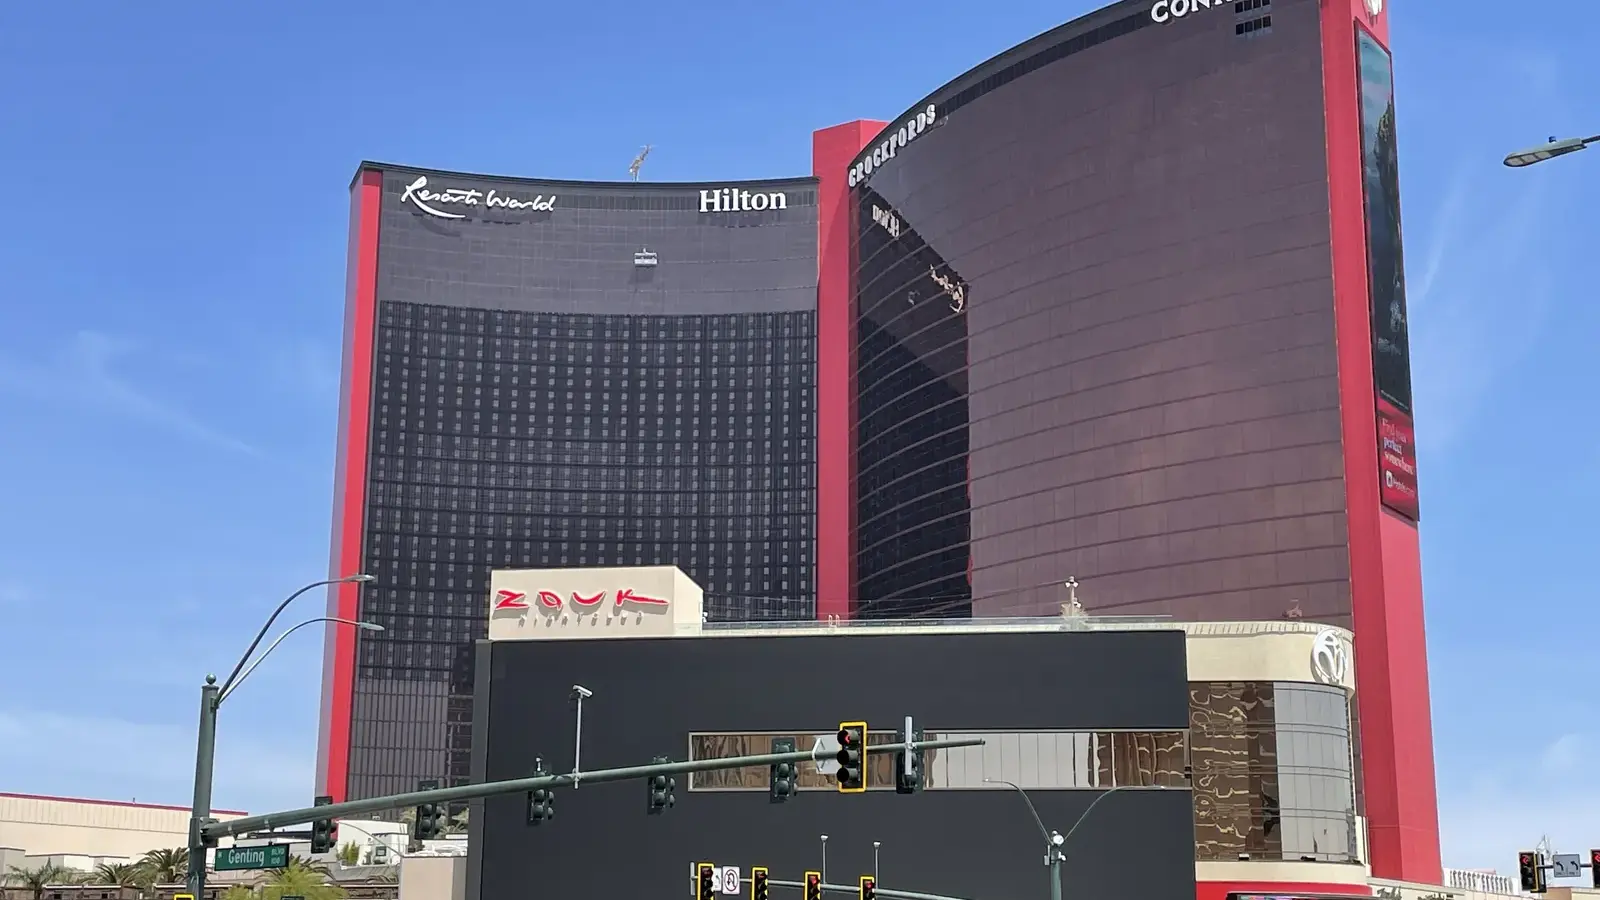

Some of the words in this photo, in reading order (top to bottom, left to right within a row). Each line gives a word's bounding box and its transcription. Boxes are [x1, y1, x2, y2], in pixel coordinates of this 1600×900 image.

[848, 104, 936, 187] CROCKFORDS
[401, 176, 482, 218] Resorts
[486, 189, 557, 212] World
[699, 187, 787, 213] Hilton
[496, 589, 669, 610] ZOUK
[228, 848, 265, 866] Genting
[271, 848, 284, 856] BLVD
